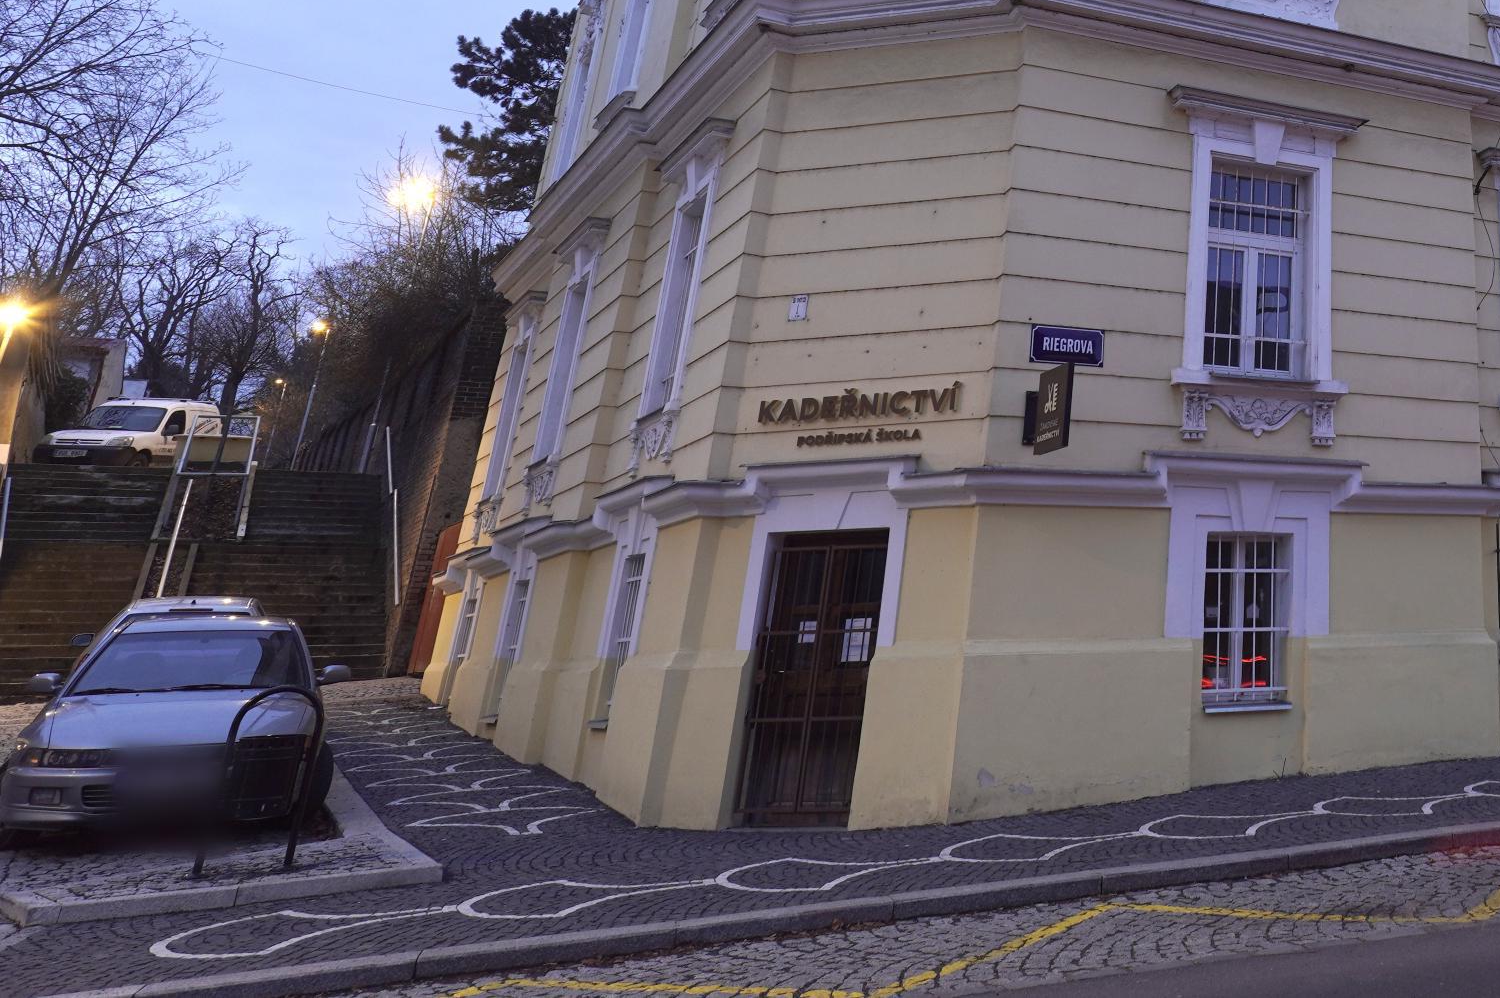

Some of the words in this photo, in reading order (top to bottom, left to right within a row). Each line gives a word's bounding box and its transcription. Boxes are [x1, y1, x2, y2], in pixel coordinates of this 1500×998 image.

[1042, 336, 1093, 354] RIEGROVA
[757, 380, 963, 424] KADEŘNICTVÍ
[797, 429, 874, 447] PODŘIPSKÁ
[875, 427, 922, 443] ŠKOLA
